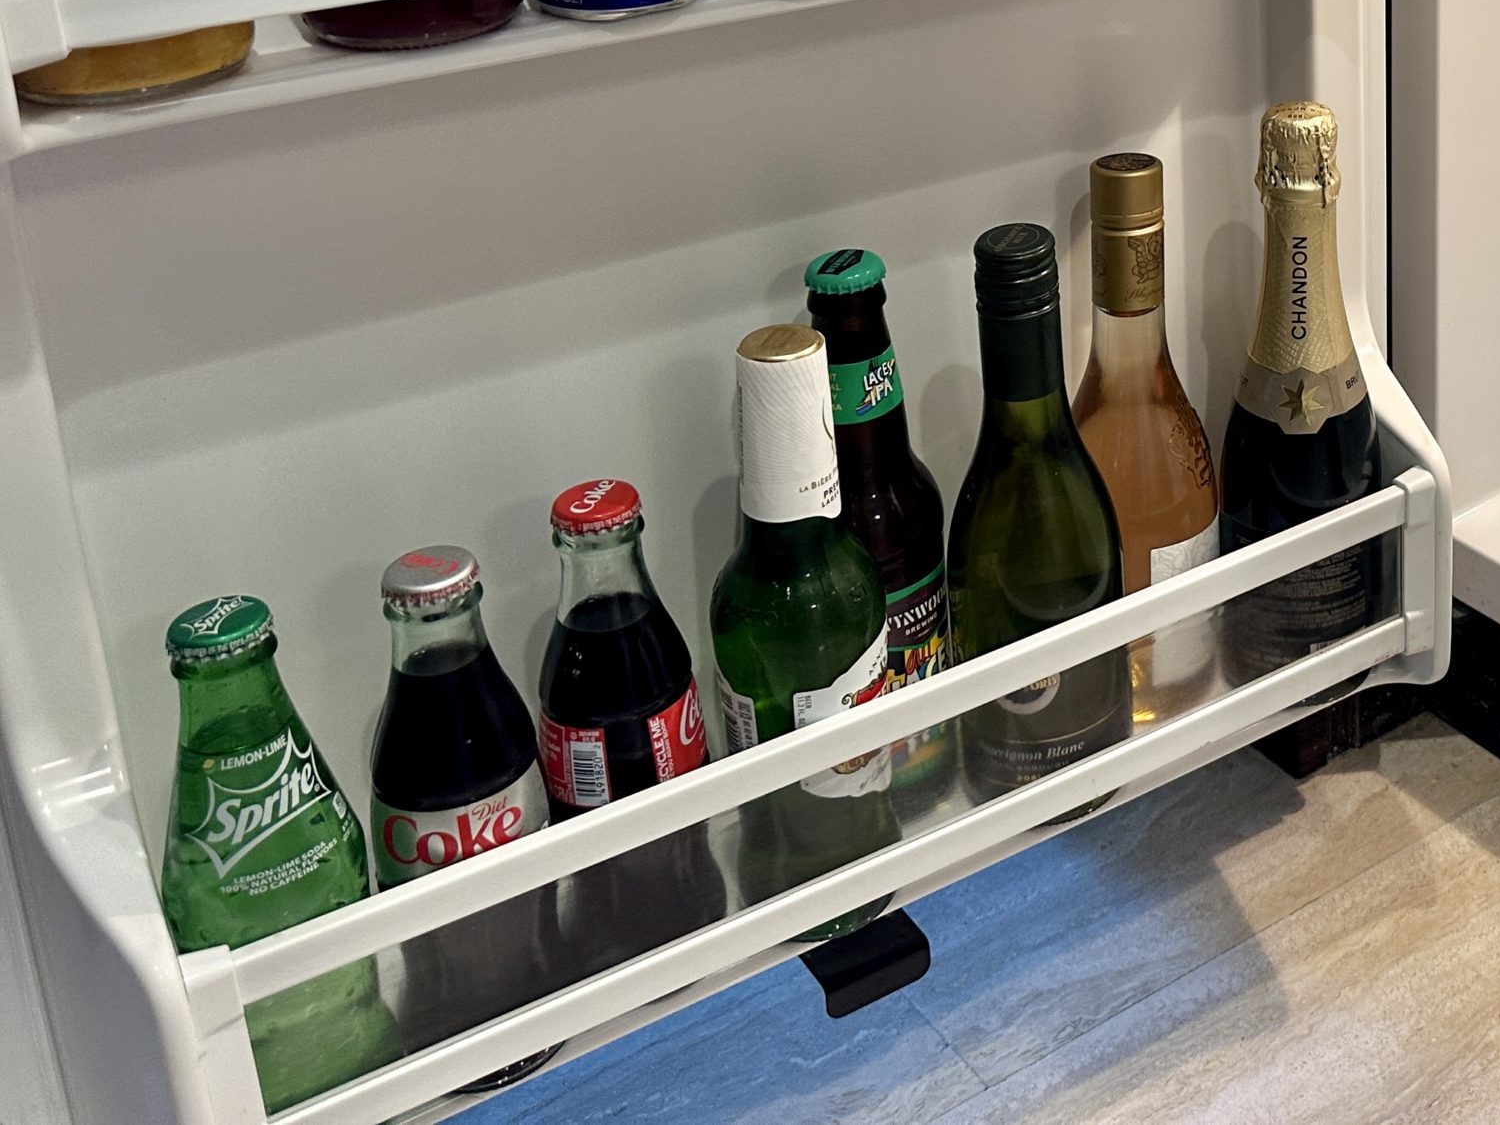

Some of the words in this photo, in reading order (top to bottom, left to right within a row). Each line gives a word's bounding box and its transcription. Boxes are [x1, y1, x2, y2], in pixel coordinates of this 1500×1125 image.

[1291, 237, 1307, 339] CHANDON
[870, 377, 893, 406] IPA
[570, 480, 616, 513] Coke
[194, 599, 240, 632] Sprite
[905, 611, 937, 635] BREWING
[650, 717, 662, 739] ME
[221, 734, 288, 770] LEMON-LIME
[1047, 741, 1084, 759] Blanc
[593, 757, 606, 793] 491820
[206, 762, 315, 845] Sprite
[472, 796, 508, 820] Diet
[383, 806, 524, 865] Coke
[221, 882, 250, 894] 100%
[251, 867, 300, 888] NATURAL
[302, 837, 338, 868] FLAVORS
[234, 857, 301, 884] LEMON-LIME
[302, 841, 326, 860] SODA
[249, 885, 268, 896] NO
[270, 862, 320, 889] CAFFEINE
